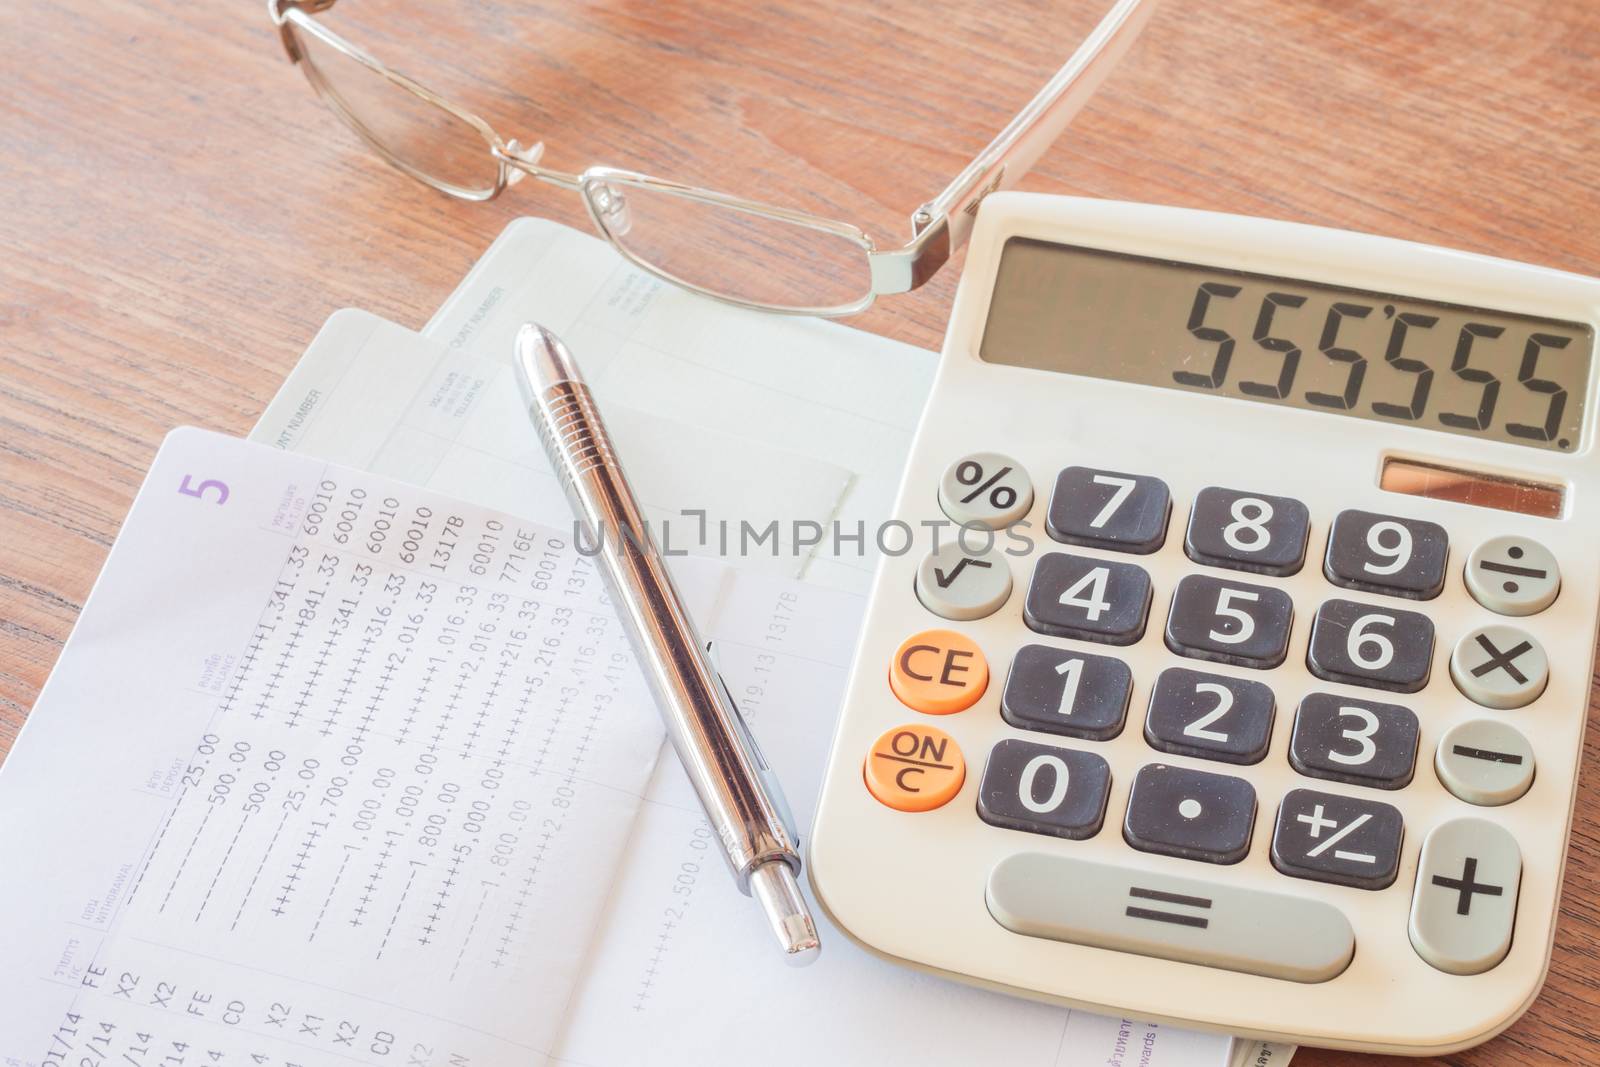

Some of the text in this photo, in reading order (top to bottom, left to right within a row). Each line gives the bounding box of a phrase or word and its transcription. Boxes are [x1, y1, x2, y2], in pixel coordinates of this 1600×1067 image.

[178, 474, 229, 505] 5
[1090, 474, 1137, 529] 7
[1223, 497, 1275, 552] 8
[1363, 520, 1414, 576] 9
[1058, 566, 1111, 622] 4
[1208, 587, 1261, 644] 5
[900, 644, 975, 688] CE
[1346, 613, 1397, 670] 6
[1054, 658, 1085, 715] 1
[1183, 683, 1234, 743] 2
[82, 963, 107, 988] FE
[304, 480, 337, 535] 60010
[113, 972, 141, 998] X2
[333, 489, 366, 544] 60010
[150, 982, 177, 1008] X2
[366, 497, 399, 553] 60010
[187, 991, 213, 1016] FE
[400, 507, 432, 563] 60010
[891, 730, 948, 762] ON
[1327, 706, 1380, 766] 3
[160, 757, 186, 793] DEPOSIT
[222, 1001, 246, 1025] CD
[430, 515, 464, 572] 1317B
[264, 1002, 292, 1028] X2
[469, 520, 504, 575] 60010
[299, 1014, 325, 1037] X1
[499, 528, 536, 583] 7716E
[333, 1021, 360, 1047] X2
[531, 538, 565, 591] 60010
[895, 767, 925, 793] C
[1018, 754, 1070, 814] 0
[370, 1031, 395, 1056] CD
[564, 555, 593, 597] 1317
[96, 862, 134, 924] WITHDRAWAL
[1138, 1031, 1157, 1067] wards
